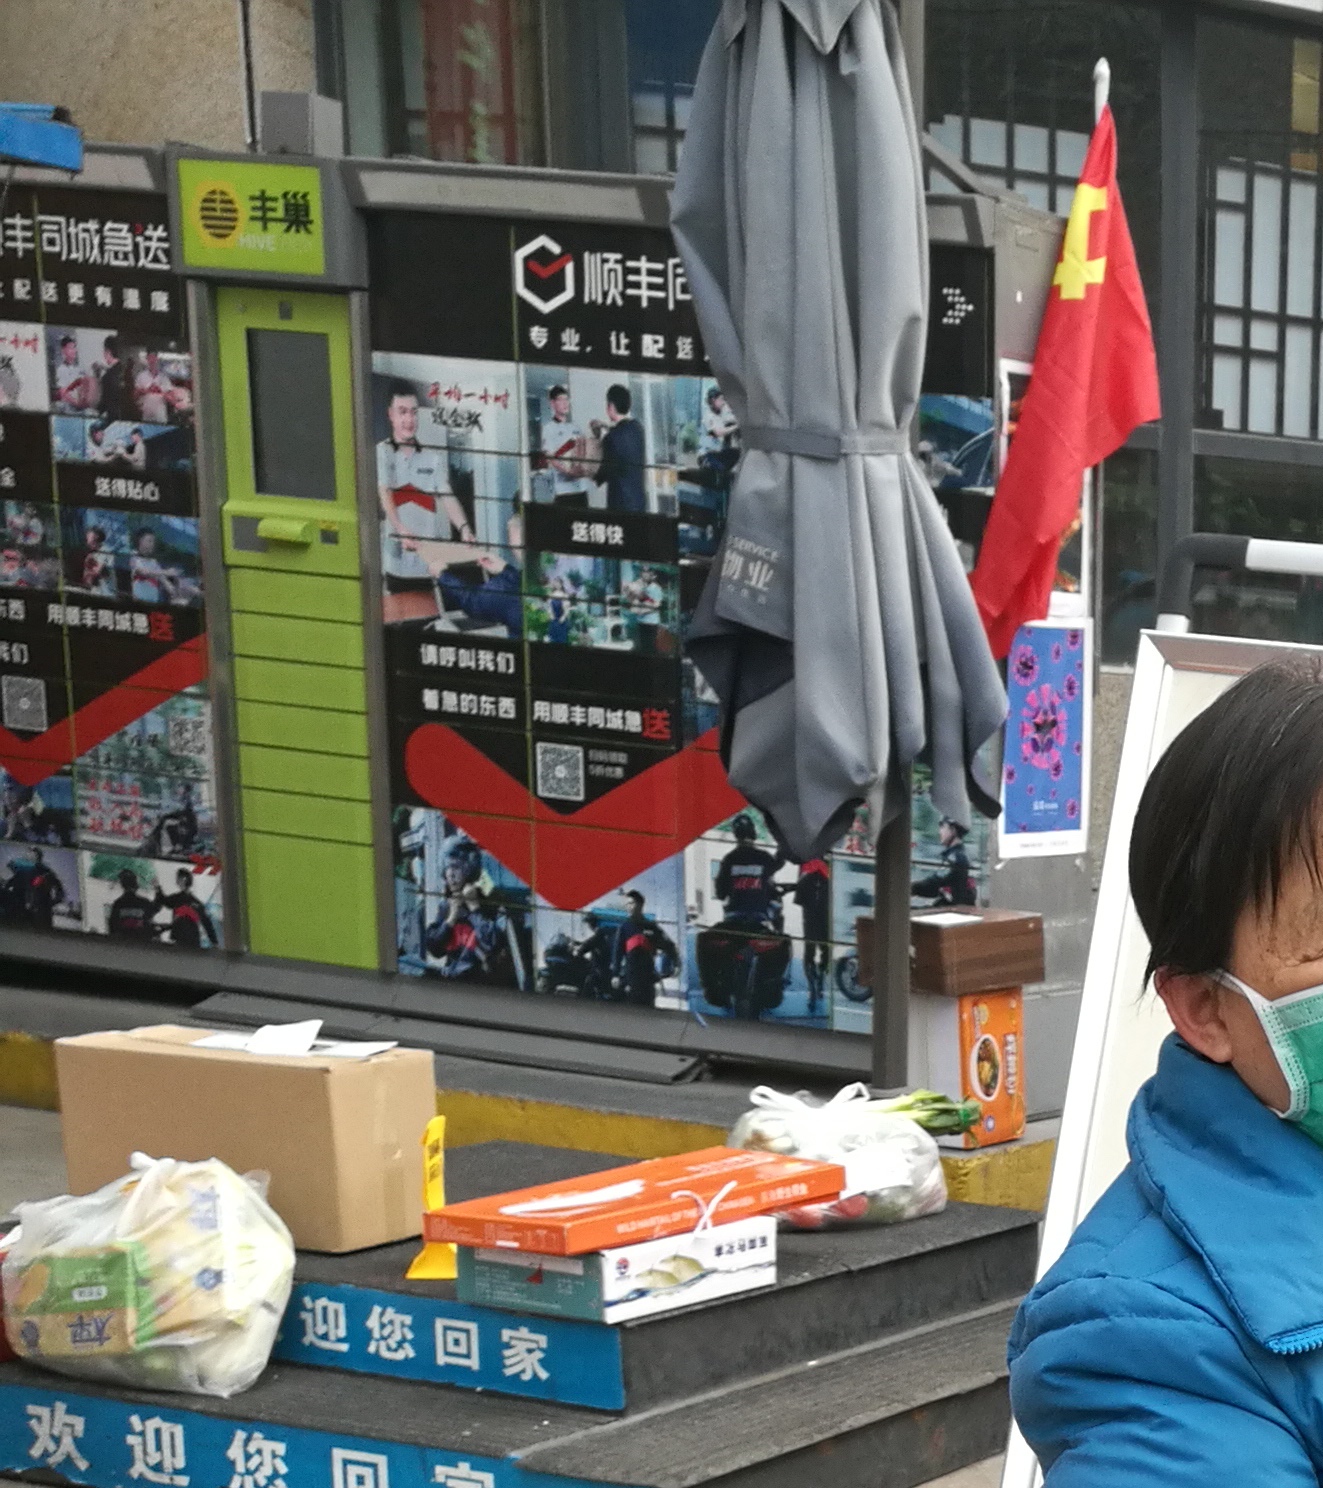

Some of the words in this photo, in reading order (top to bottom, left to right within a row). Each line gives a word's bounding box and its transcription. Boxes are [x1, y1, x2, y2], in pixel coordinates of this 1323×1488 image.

[248, 188, 314, 235] 丰巢
[0, 213, 171, 271] 丰同城急送
[529, 324, 711, 362] 专业，让配送
[571, 521, 624, 546] 送得快
[420, 643, 516, 675] 请呼叫我们
[422, 687, 517, 720] 着急的东西
[533, 699, 672, 740] 用顺丰同城急送
[299, 1294, 551, 1382] 迎您回家
